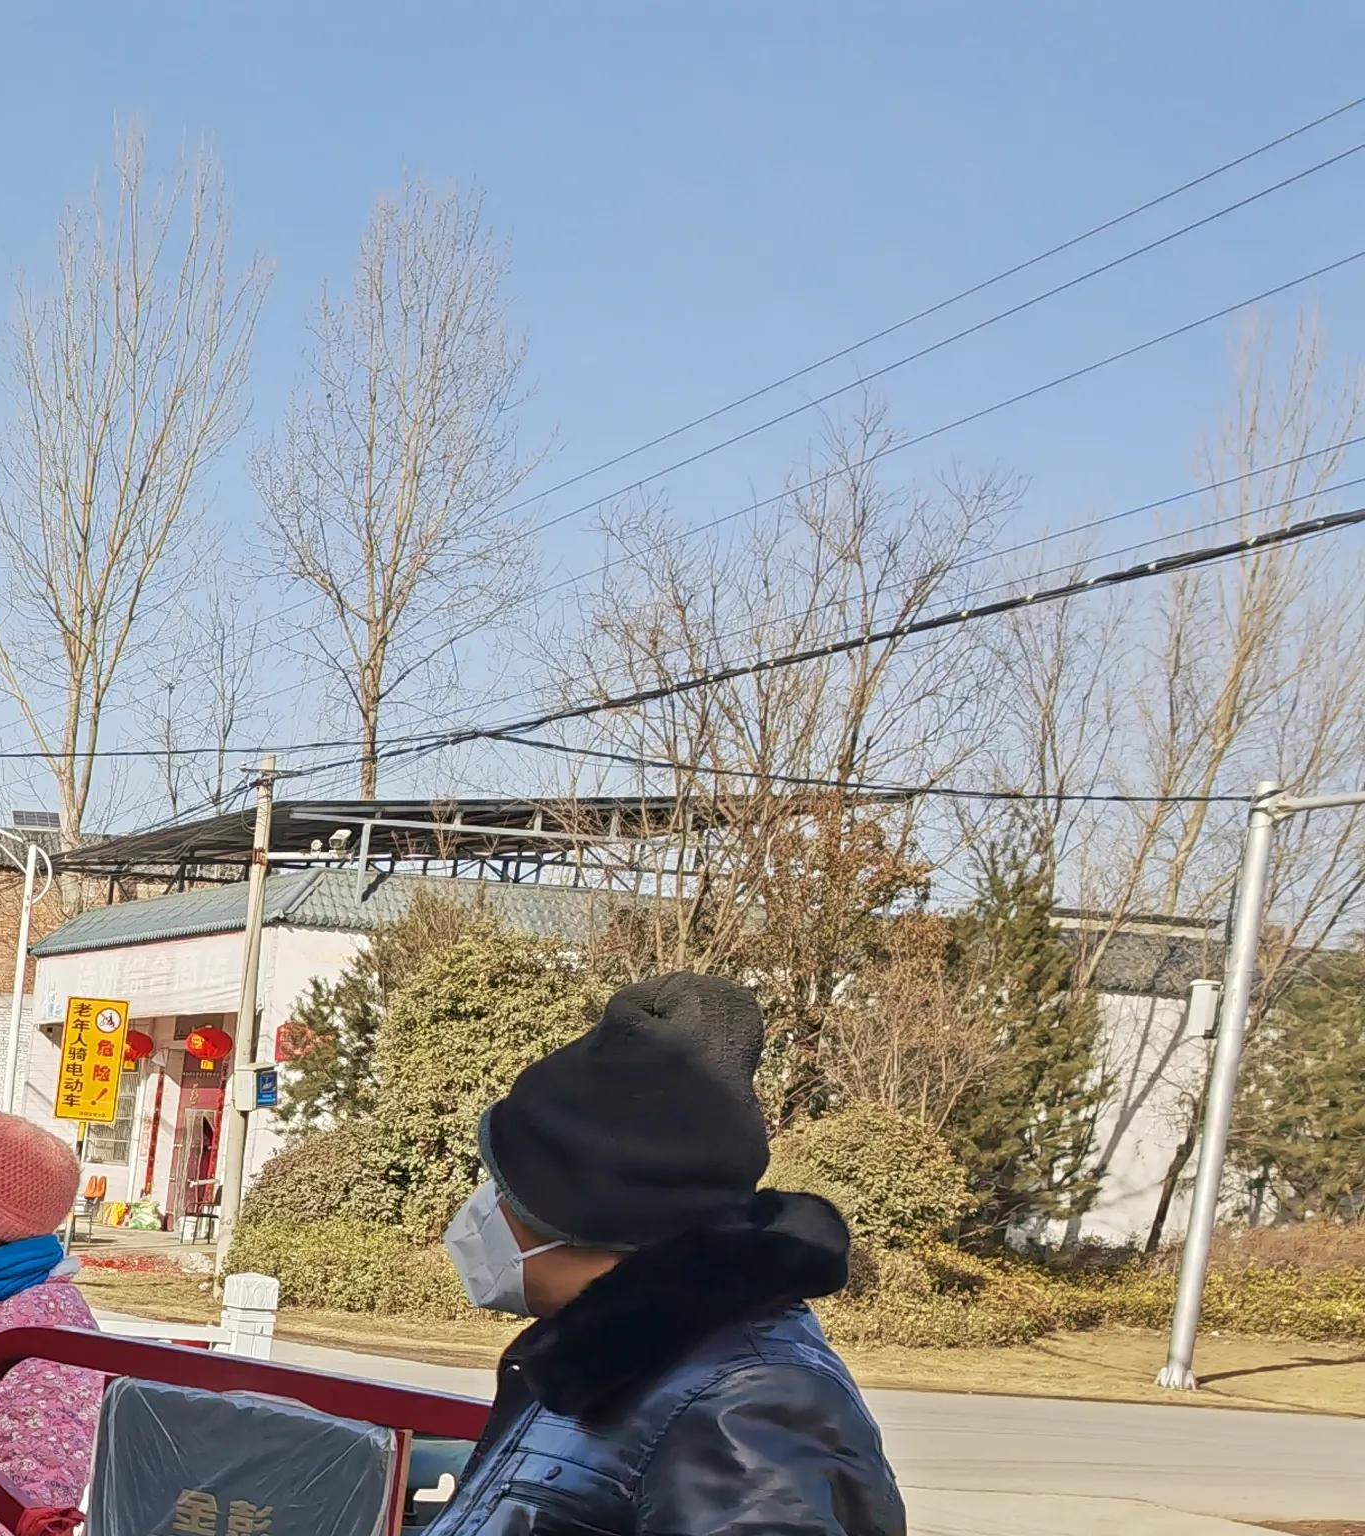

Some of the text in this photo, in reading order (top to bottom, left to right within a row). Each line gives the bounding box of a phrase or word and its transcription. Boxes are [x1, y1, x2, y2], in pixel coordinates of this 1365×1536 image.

[61, 1002, 94, 1108] 老年人骑电动车
